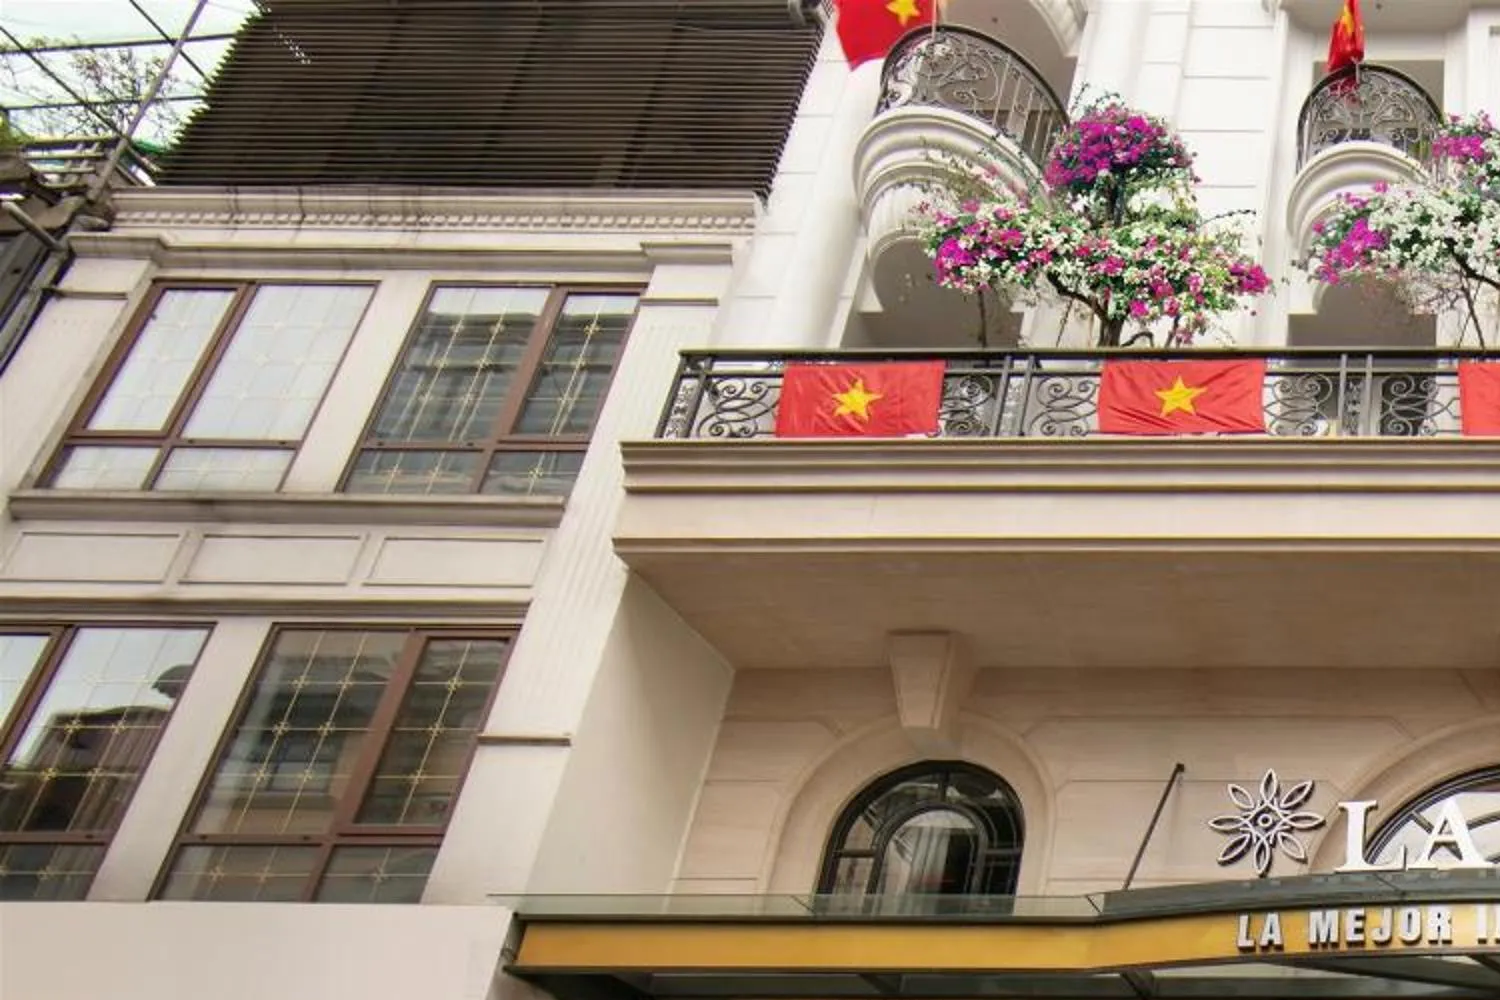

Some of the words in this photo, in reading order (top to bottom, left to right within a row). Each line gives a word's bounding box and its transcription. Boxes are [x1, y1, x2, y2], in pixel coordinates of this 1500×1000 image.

[1334, 797, 1496, 872] LA
[1237, 911, 1285, 950] LA
[1308, 904, 1453, 948] MEJOR
